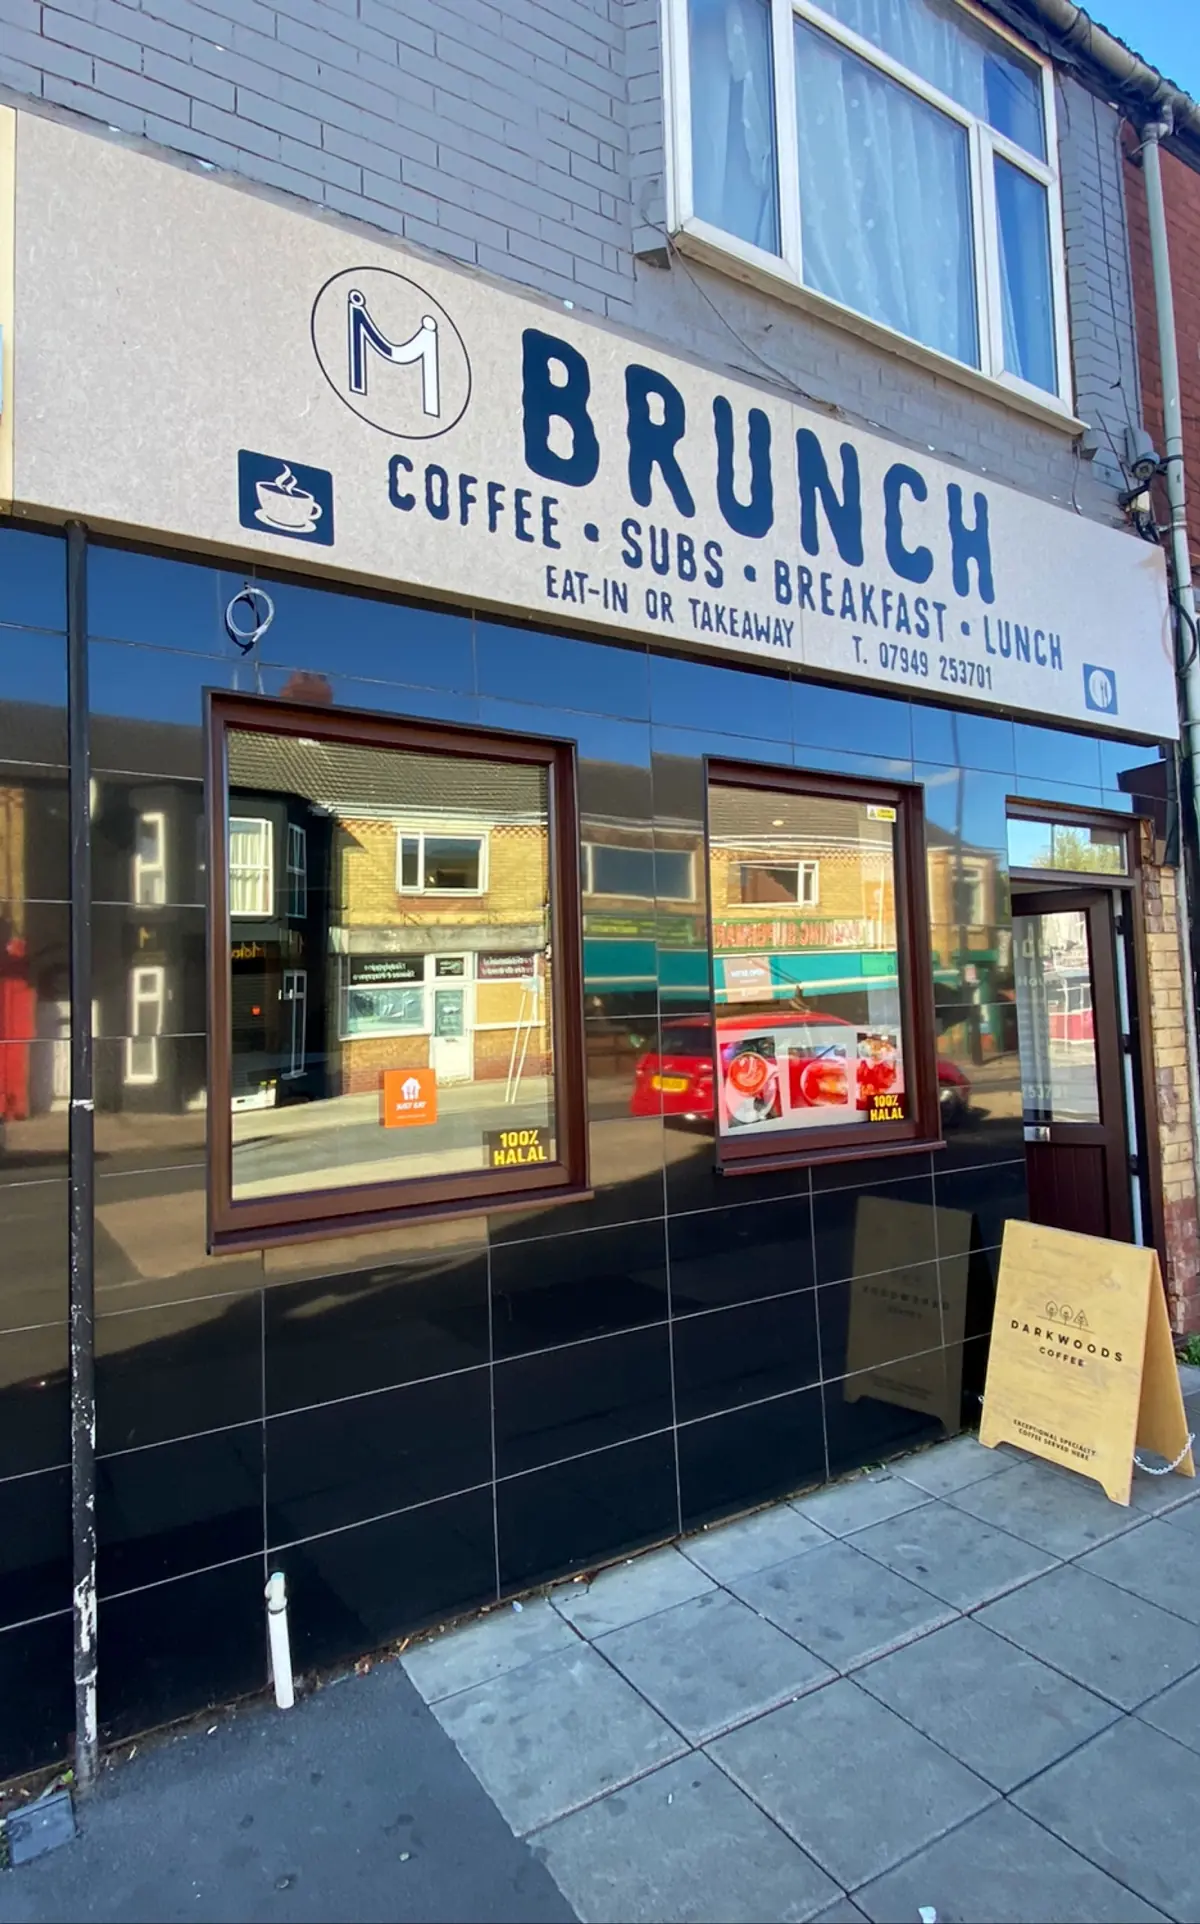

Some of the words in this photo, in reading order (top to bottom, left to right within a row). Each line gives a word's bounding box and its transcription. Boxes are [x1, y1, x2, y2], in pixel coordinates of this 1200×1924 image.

[522, 328, 995, 604] BRUNCH
[388, 454, 561, 549] COFFEE
[621, 518, 723, 588] SUBS
[774, 559, 947, 642] BREAKFAST
[984, 614, 1063, 671] LUNCH
[546, 565, 628, 614] EAT-IN
[646, 588, 674, 623] OR
[688, 598, 794, 648] TAKEAWAY
[852, 636, 868, 664] T.
[879, 642, 928, 677] 07949
[939, 655, 992, 690] 253701
[870, 1107, 904, 1121] HALAL
[873, 1094, 899, 1108] 100%
[494, 1145, 547, 1166] HALAL
[500, 1129, 539, 1148] 100%
[1011, 1320, 1123, 1362] DARKWOODS
[1039, 1346, 1085, 1367] COFFEE
[1013, 1419, 1057, 1442] EXCEPTIONAL
[1059, 1437, 1096, 1456] SPECIALTY
[1018, 1428, 1041, 1443] COFFEE
[1044, 1438, 1069, 1453] SERVED
[1071, 1450, 1089, 1462] HERE
